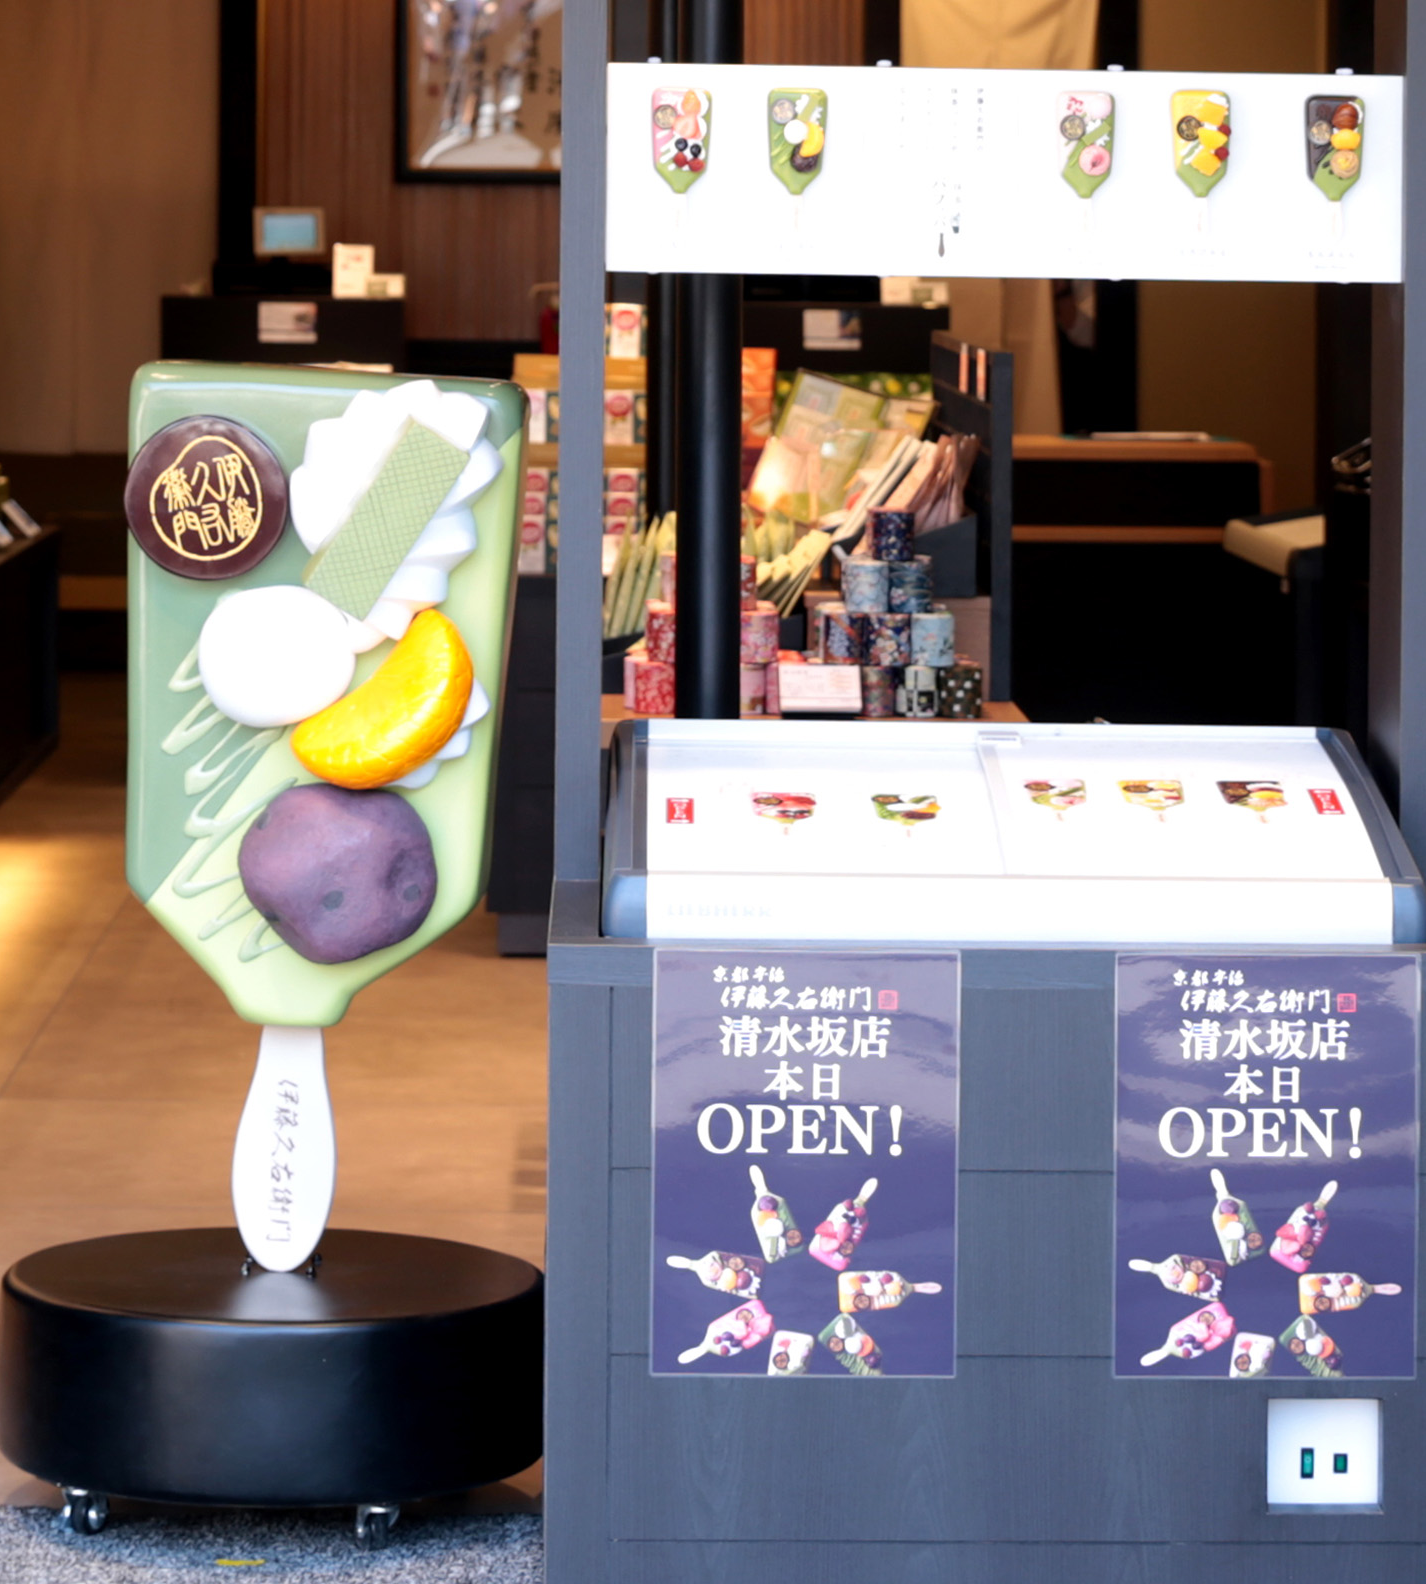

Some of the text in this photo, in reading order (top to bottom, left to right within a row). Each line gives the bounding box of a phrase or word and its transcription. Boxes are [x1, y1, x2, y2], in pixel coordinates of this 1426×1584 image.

[721, 985, 871, 1011] 伊藤久右衛門
[1181, 989, 1329, 1013] 伊藤久右衛門
[720, 1015, 891, 1058] 清水坂店
[1180, 1019, 1349, 1060] 清水坂店
[764, 1061, 840, 1100] 本日
[1225, 1065, 1299, 1103] 本日
[698, 1104, 902, 1155] OPEN!
[1159, 1107, 1361, 1158] OPEN!
